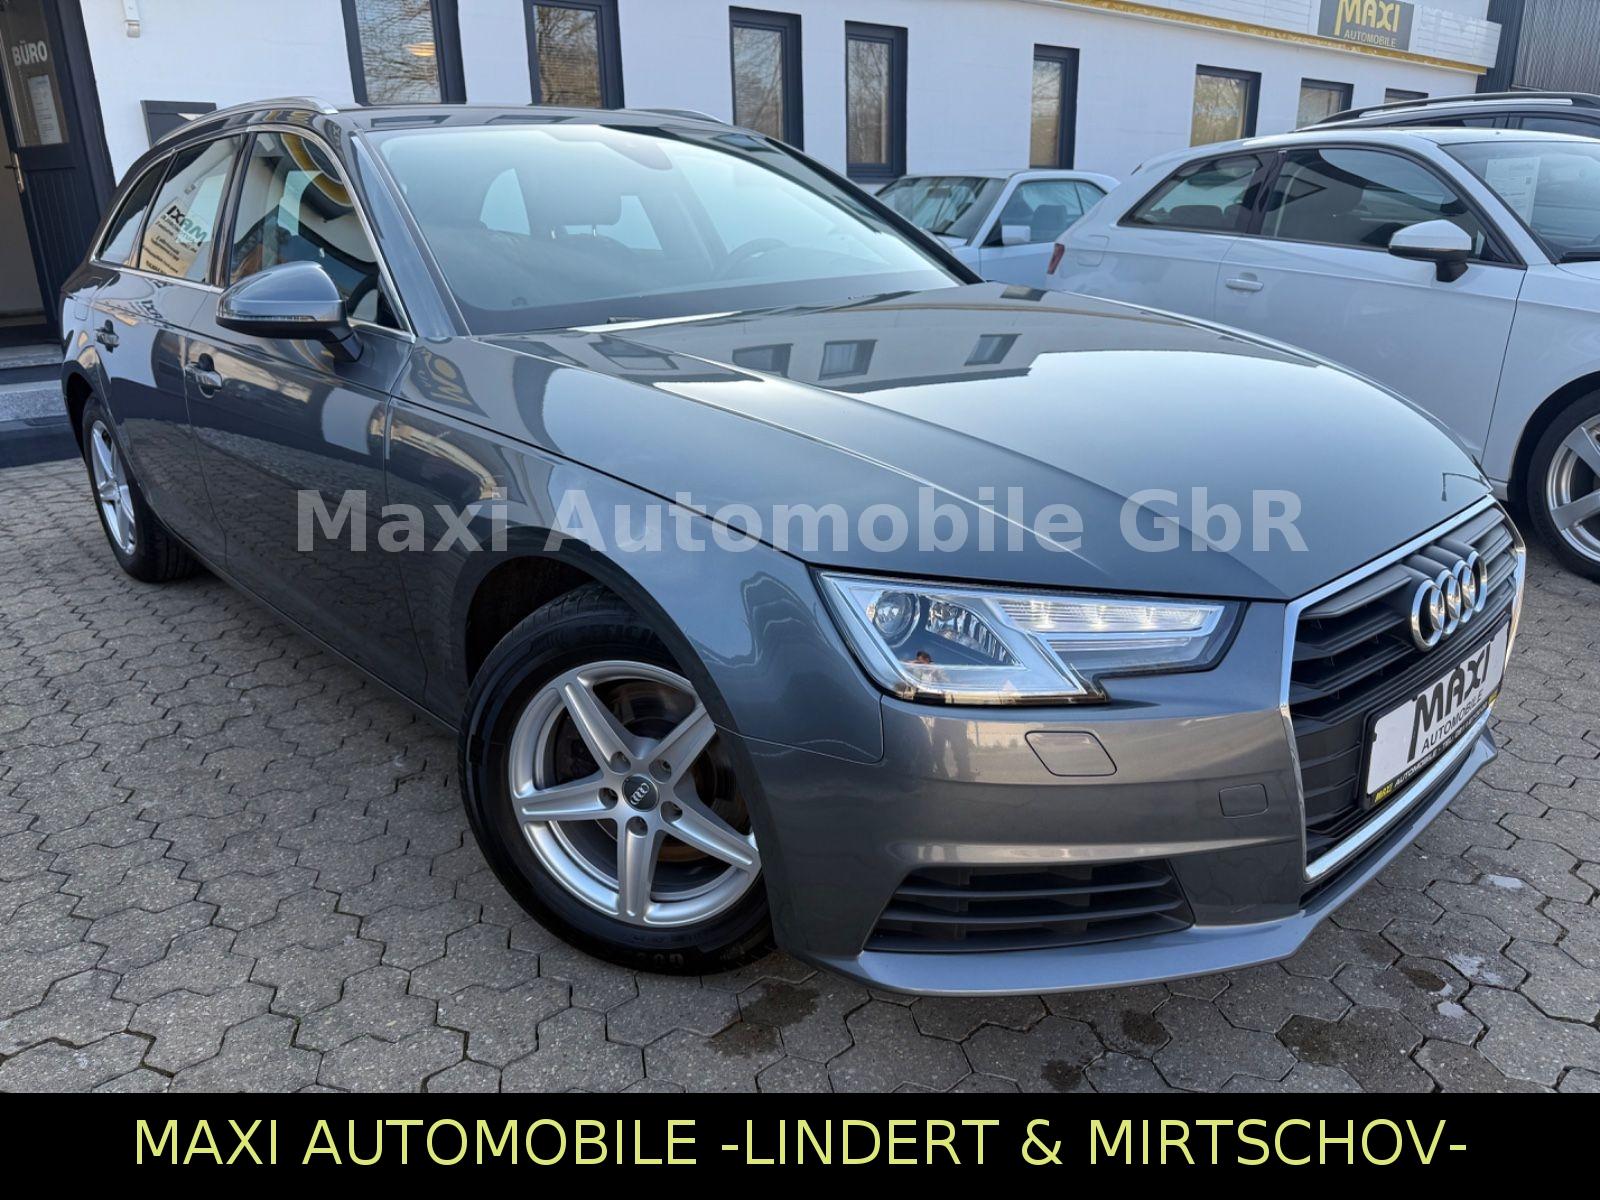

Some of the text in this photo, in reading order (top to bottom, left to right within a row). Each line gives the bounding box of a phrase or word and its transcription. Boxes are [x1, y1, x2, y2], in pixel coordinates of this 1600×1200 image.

[1334, 0, 1400, 36] MAXI
[12, 40, 48, 67] BÜRO
[1344, 29, 1397, 48] AUTOMOBILE
[1407, 643, 1491, 763] MAXI
[1421, 688, 1484, 753] AUTOMOBILE
